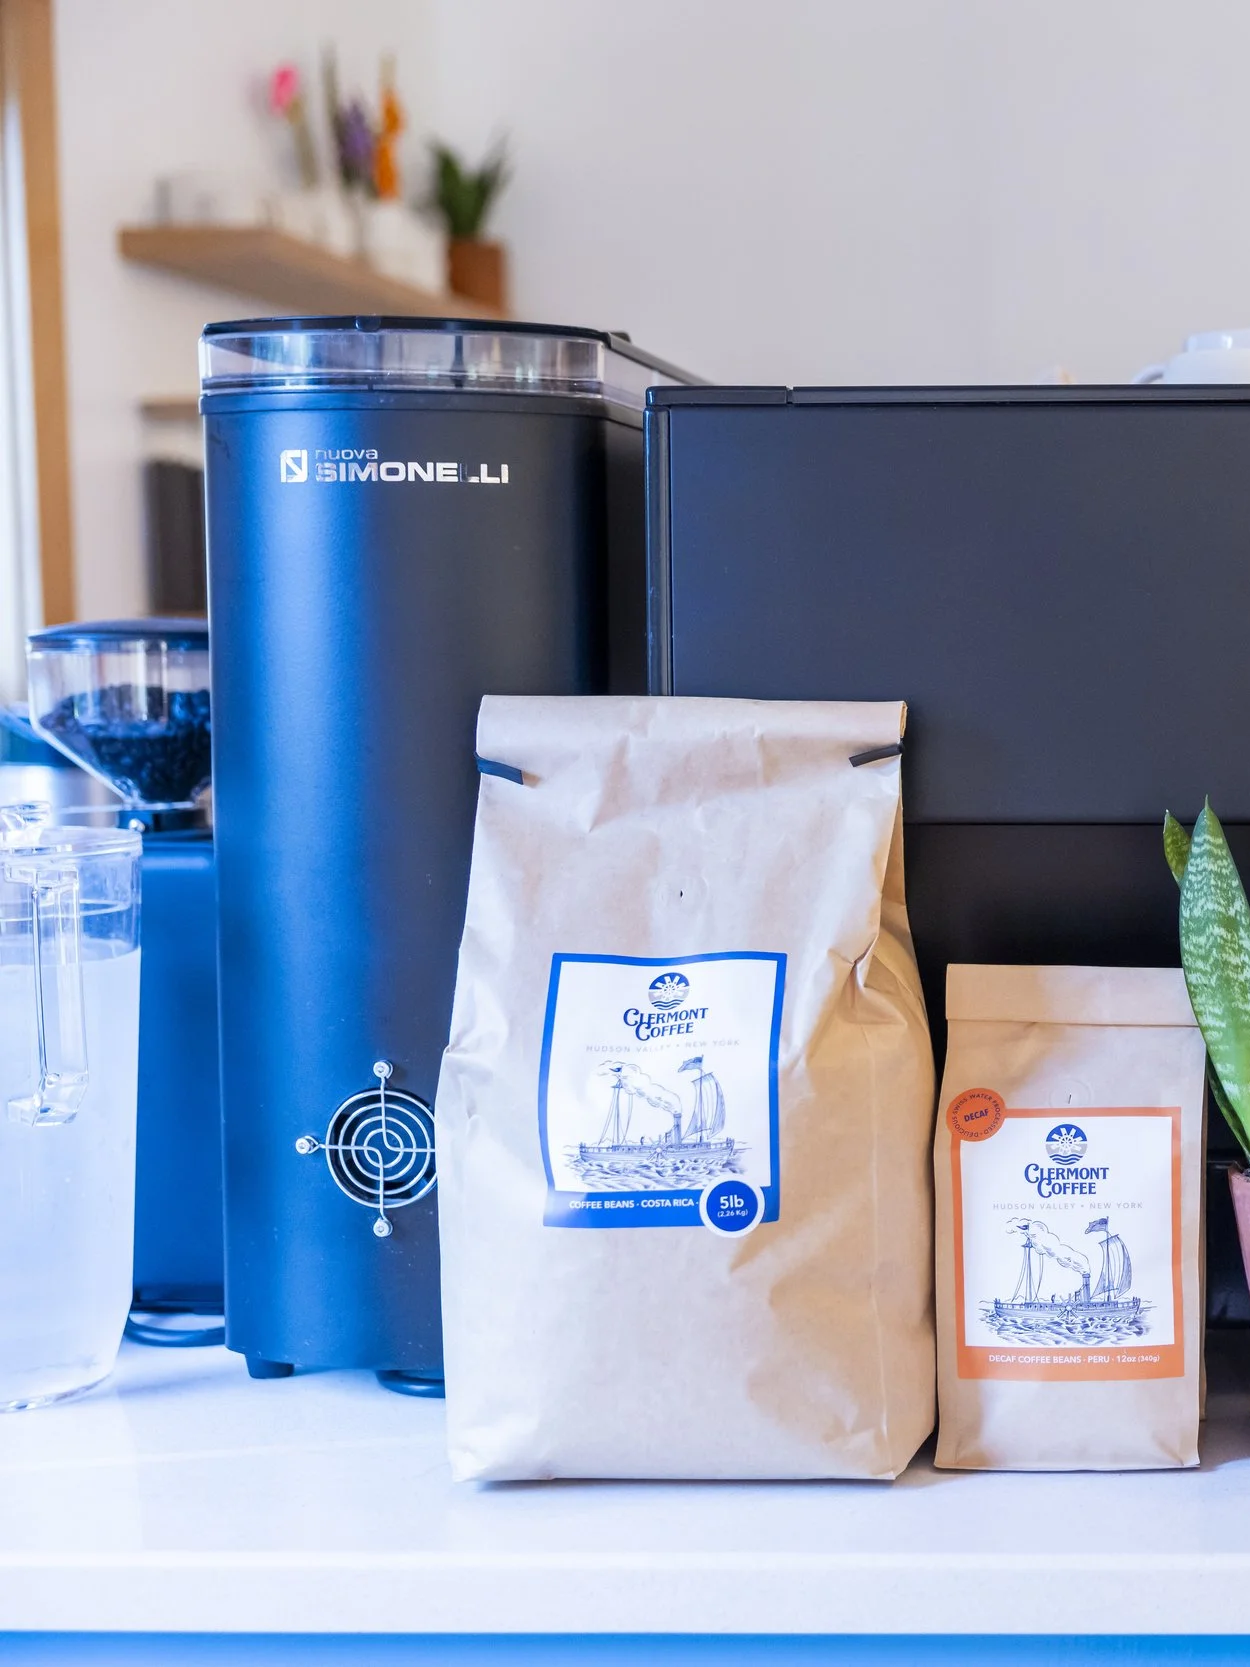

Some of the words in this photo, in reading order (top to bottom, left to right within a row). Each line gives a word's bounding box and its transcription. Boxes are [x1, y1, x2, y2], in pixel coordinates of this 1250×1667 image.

[315, 448, 378, 460] nuova
[316, 461, 509, 484] SIMONELLI
[623, 1007, 709, 1029] CLERMONT
[635, 1022, 694, 1041] COFFEE
[970, 1093, 992, 1101] WATER
[964, 1109, 989, 1122] DECAF
[1024, 1163, 1109, 1185] CLERMONT
[1037, 1178, 1097, 1198] COFFEE
[569, 1201, 602, 1209] COFFEE
[604, 1200, 635, 1208] BEANS
[640, 1199, 672, 1208] COSTA
[673, 1198, 694, 1207] RICA
[719, 1195, 745, 1209] 5lb
[1018, 1355, 1051, 1363] COFFEE
[1052, 1355, 1081, 1363] BEANS
[1087, 1355, 1110, 1363] PERU
[1116, 1355, 1137, 1363] 12oz
